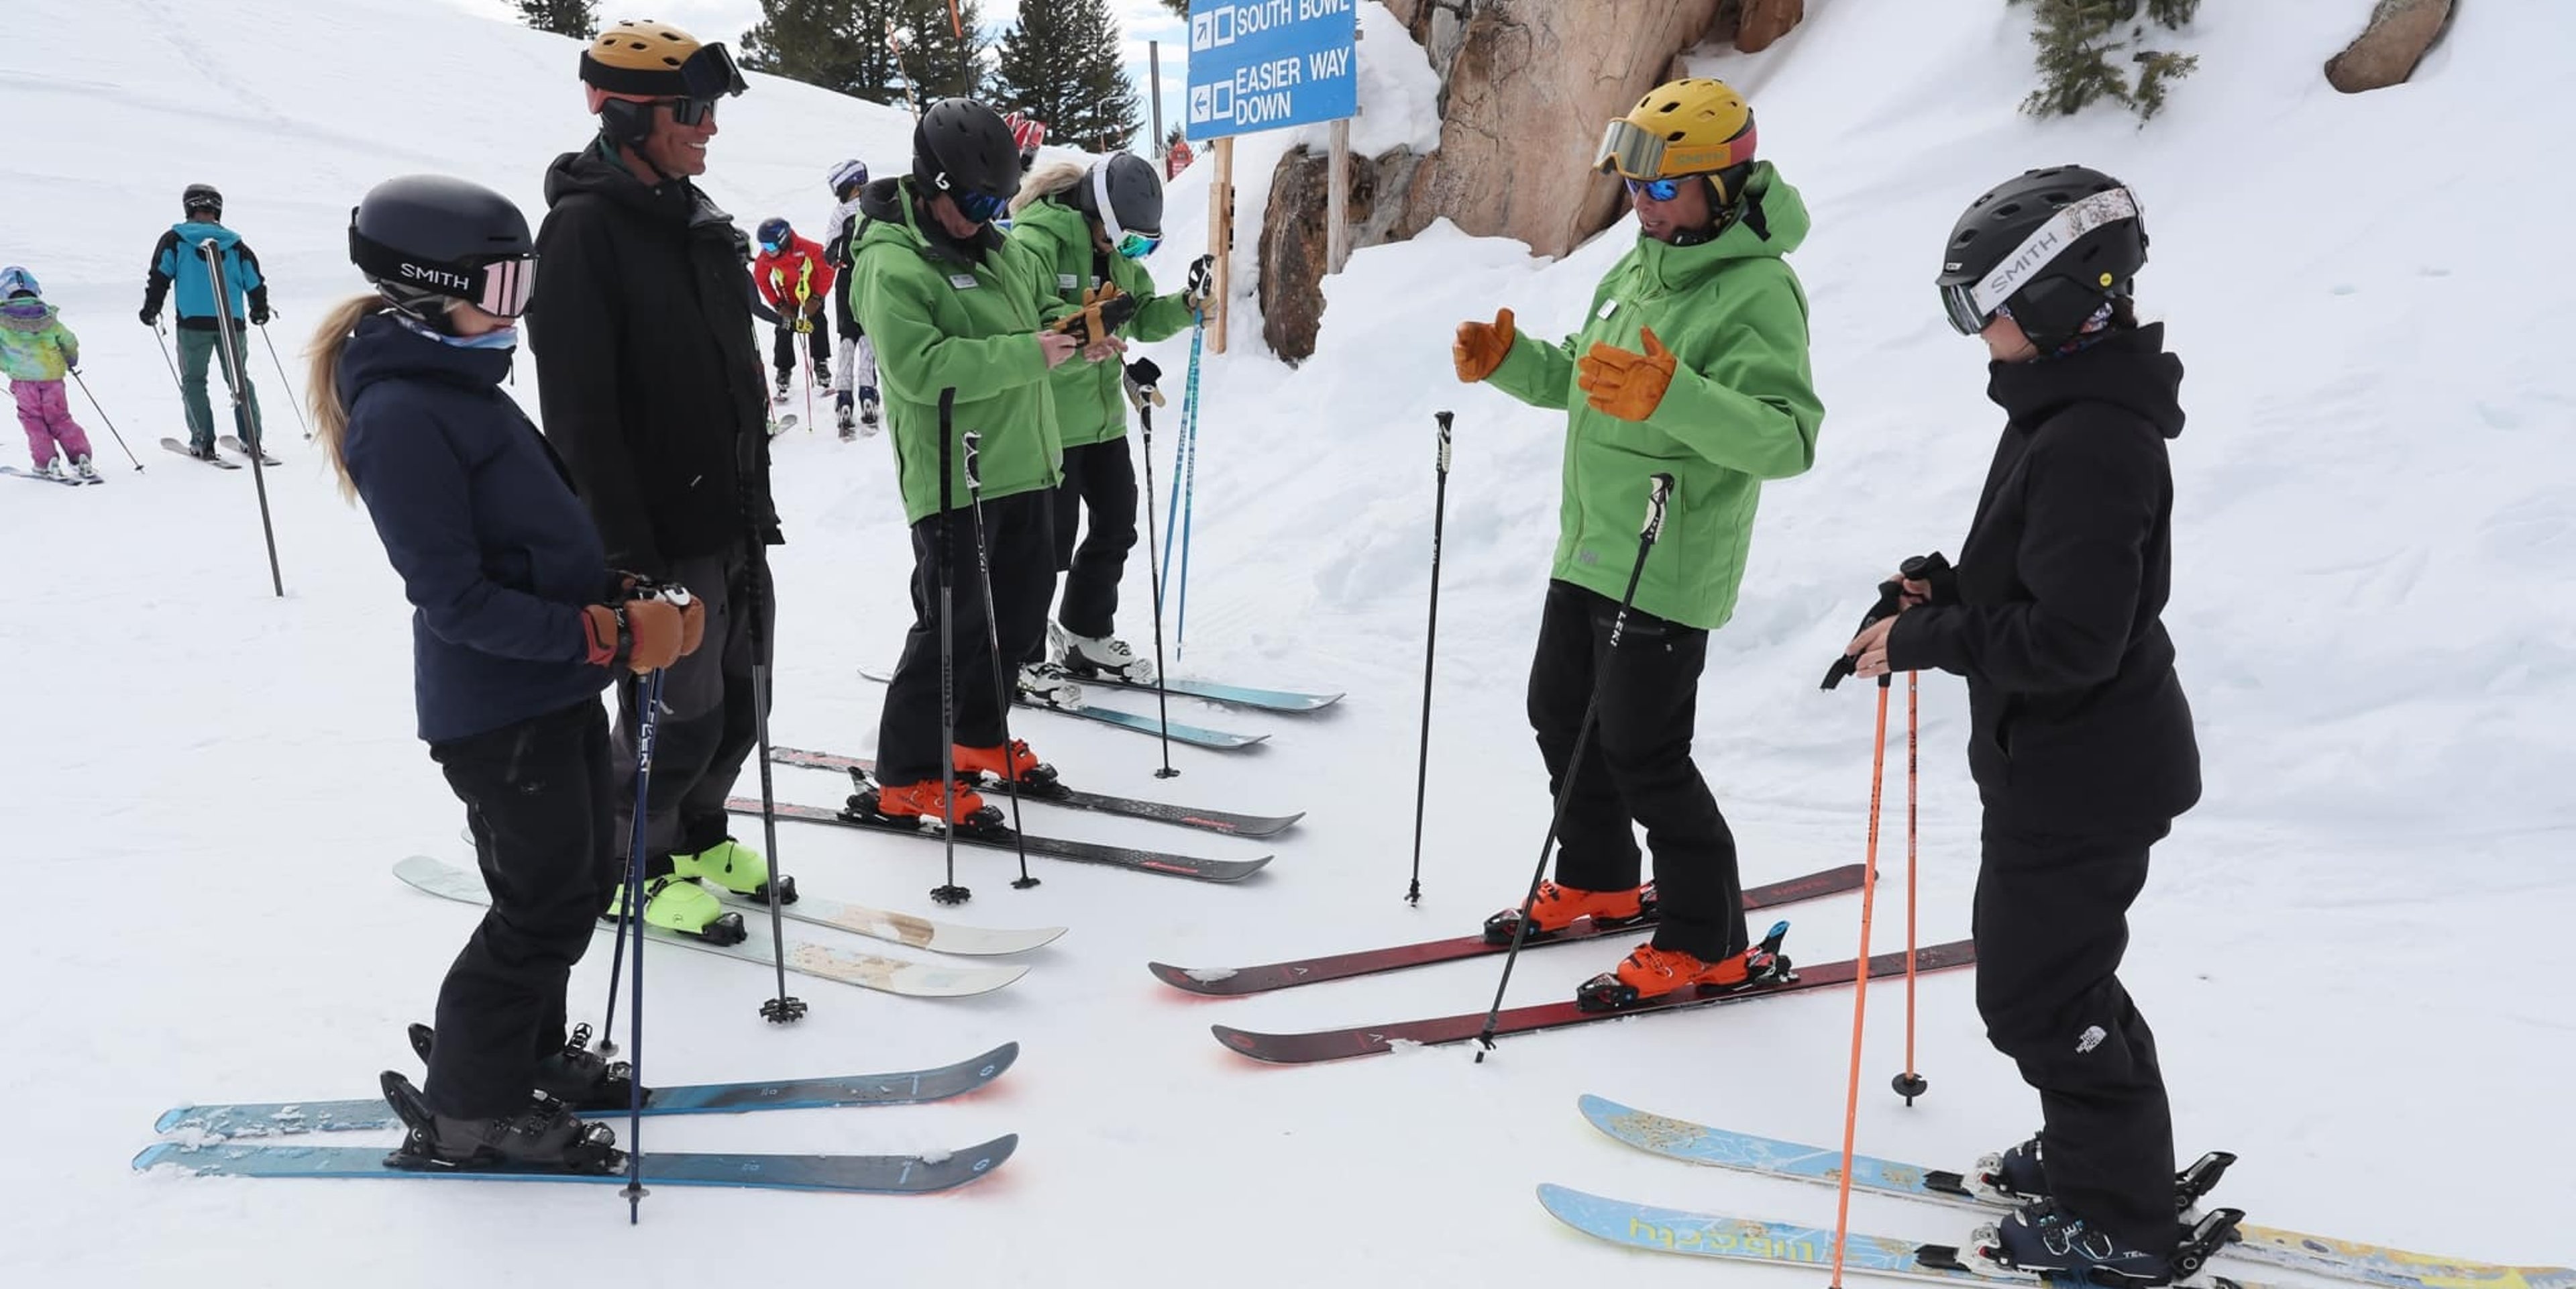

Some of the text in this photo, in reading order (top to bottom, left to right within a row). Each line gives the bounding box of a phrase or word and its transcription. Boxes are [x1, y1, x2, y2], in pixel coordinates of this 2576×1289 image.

[1237, 0, 1292, 36] SOUTH
[1236, 46, 1350, 95] EASIER WAY
[1236, 91, 1291, 125] DOWN
[400, 262, 470, 291] SMITH
[1991, 232, 2058, 294] SMITH
[1611, 611, 1626, 648] LEKI
